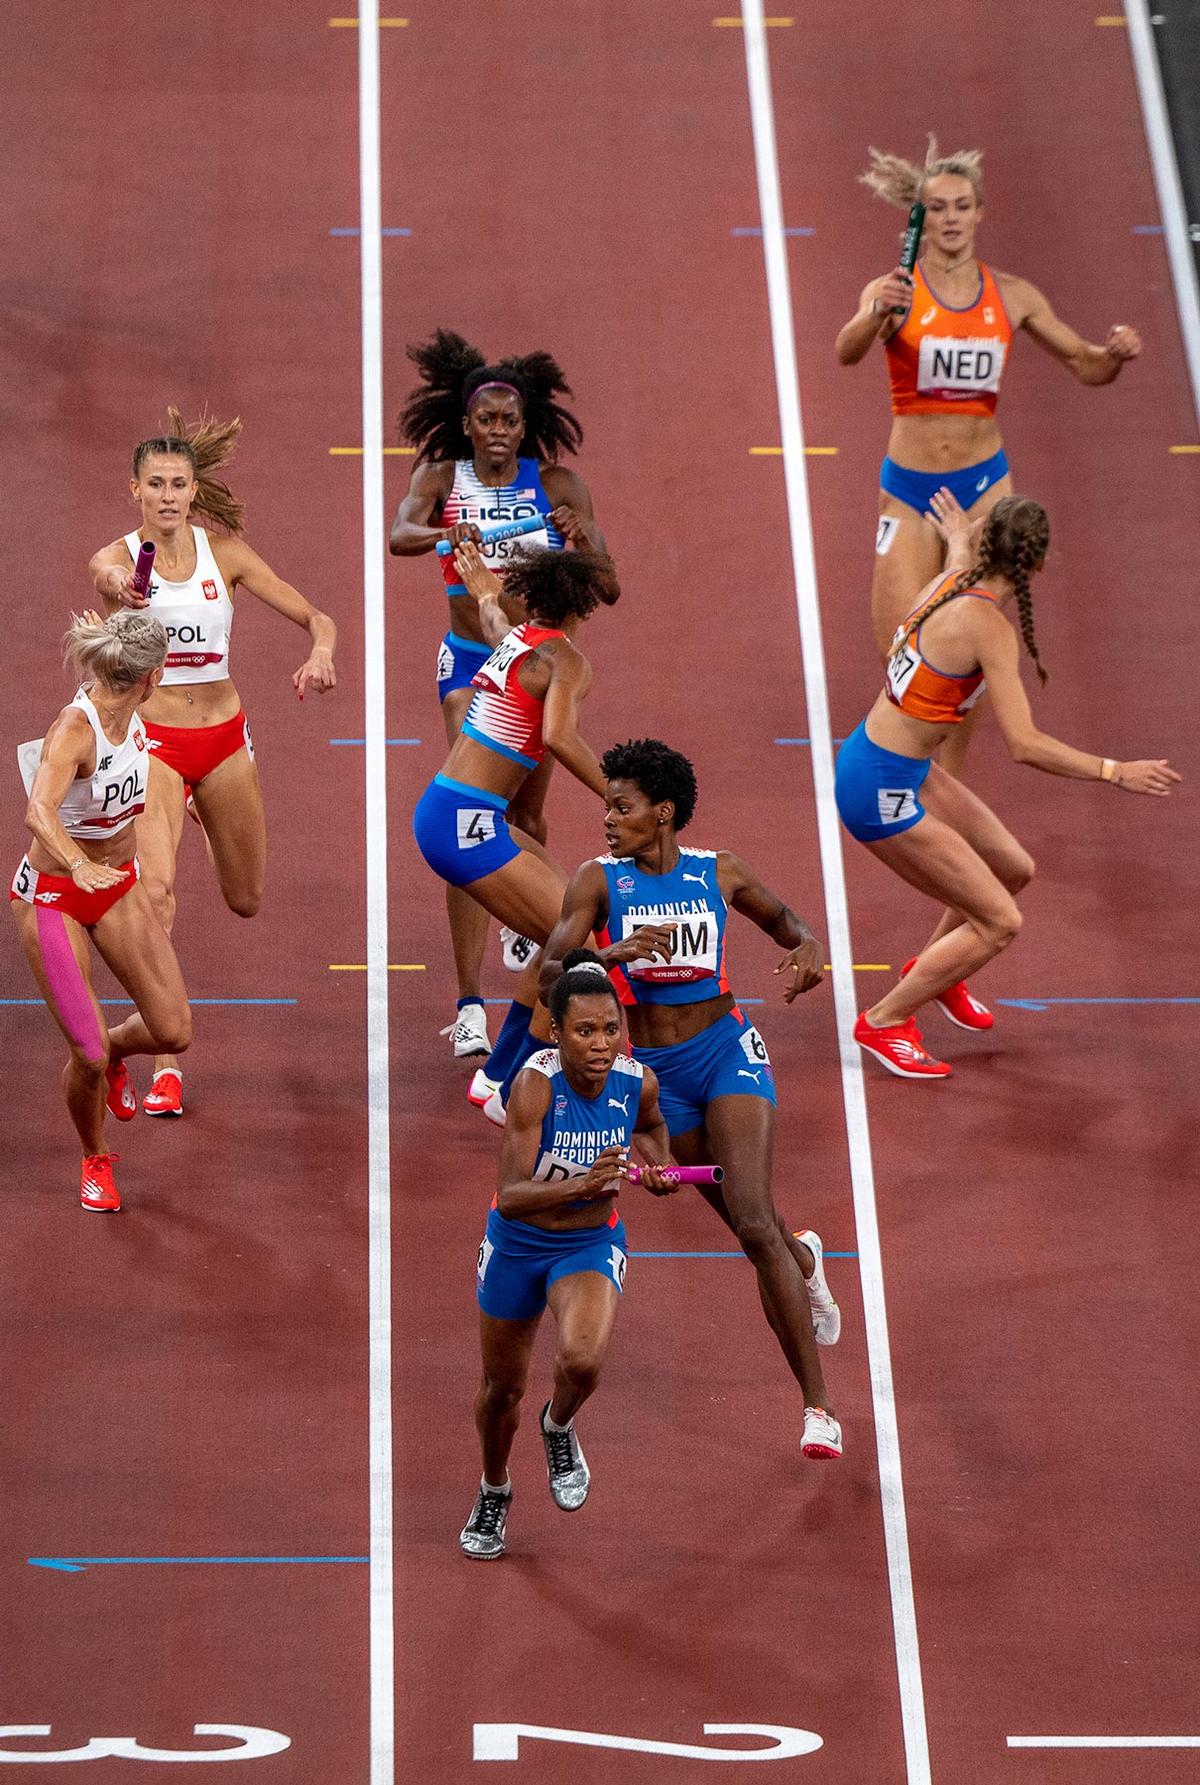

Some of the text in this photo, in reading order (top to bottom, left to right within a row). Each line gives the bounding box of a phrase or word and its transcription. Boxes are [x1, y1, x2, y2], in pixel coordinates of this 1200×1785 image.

[932, 349, 993, 380] NED
[165, 625, 206, 644] POL
[101, 769, 144, 811] POL
[886, 792, 906, 818] 7
[466, 813, 488, 842] 4
[17, 861, 30, 894] 5
[628, 898, 709, 917] DOMINICAN
[751, 1032, 766, 1060] 6
[553, 1126, 625, 1148] DOMINICAN
[473, 1723, 824, 1761] 2
